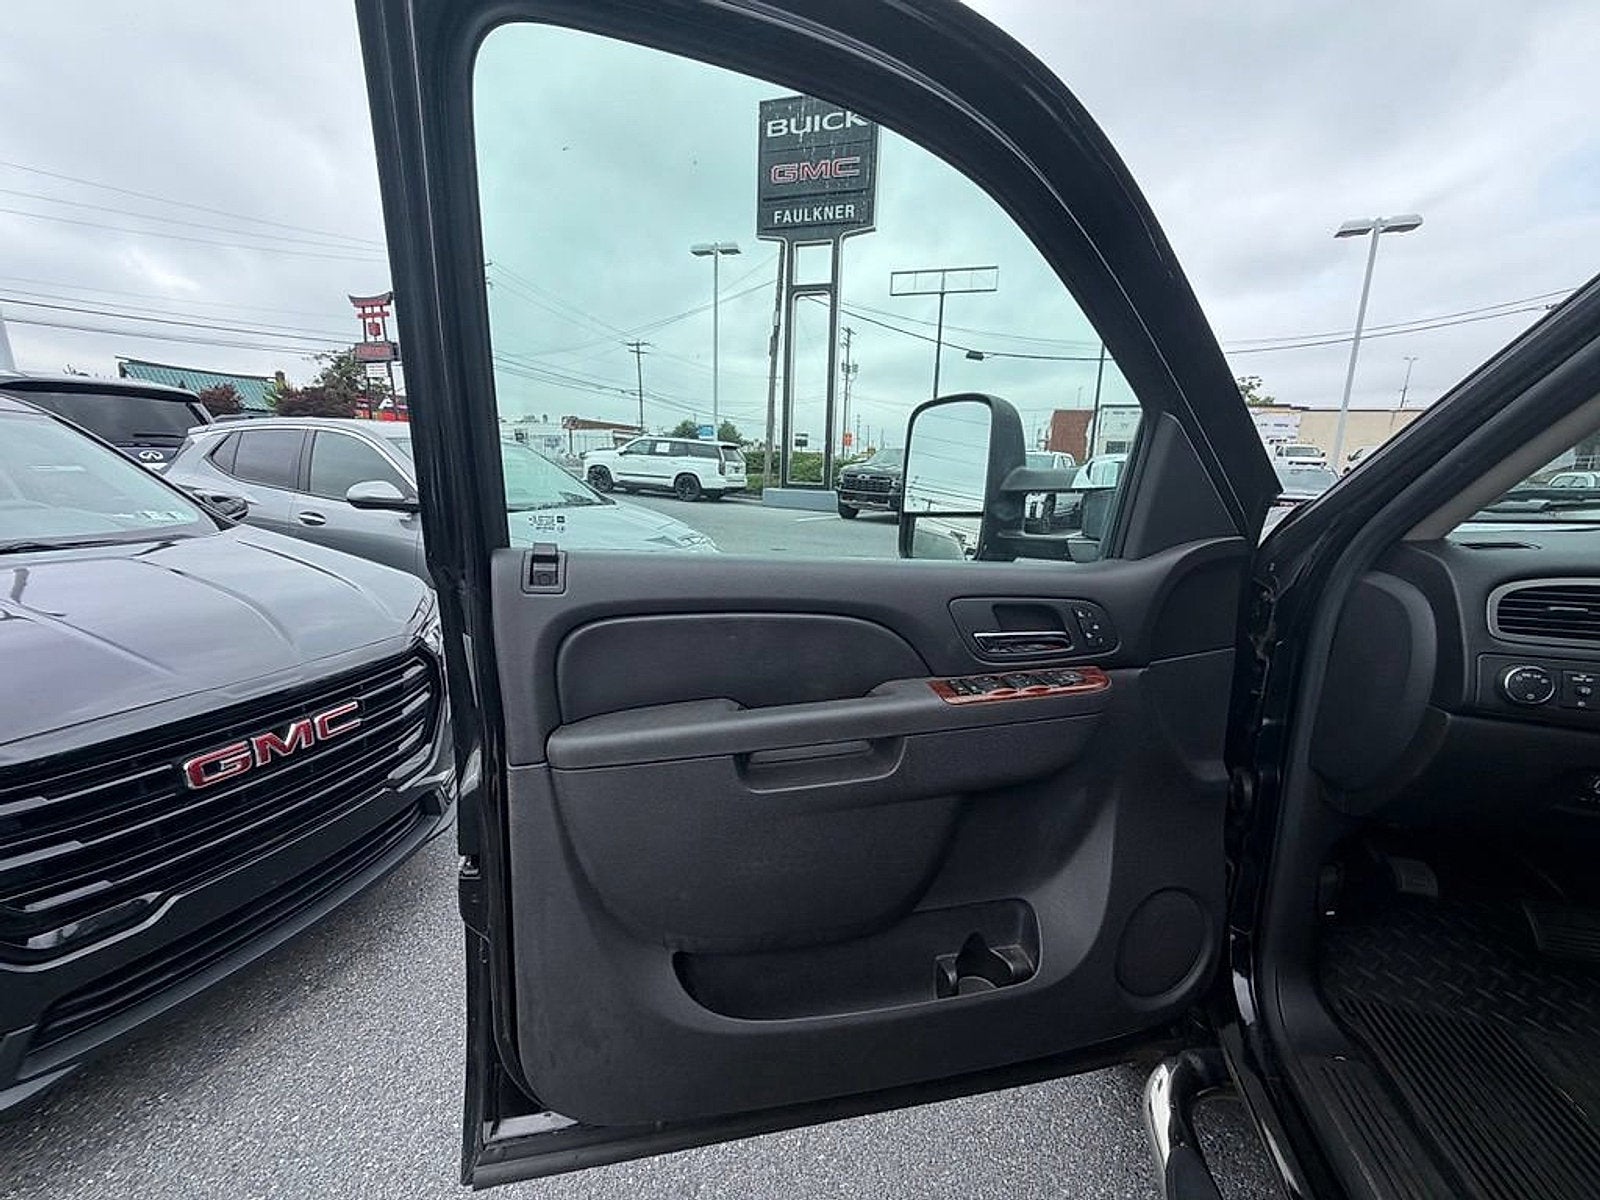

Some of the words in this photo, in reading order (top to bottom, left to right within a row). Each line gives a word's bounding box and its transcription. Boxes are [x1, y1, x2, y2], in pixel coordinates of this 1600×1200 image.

[766, 111, 868, 137] BUICK
[770, 156, 861, 184] GMC
[773, 204, 855, 224] FAULKNER
[183, 701, 362, 789] GMC
